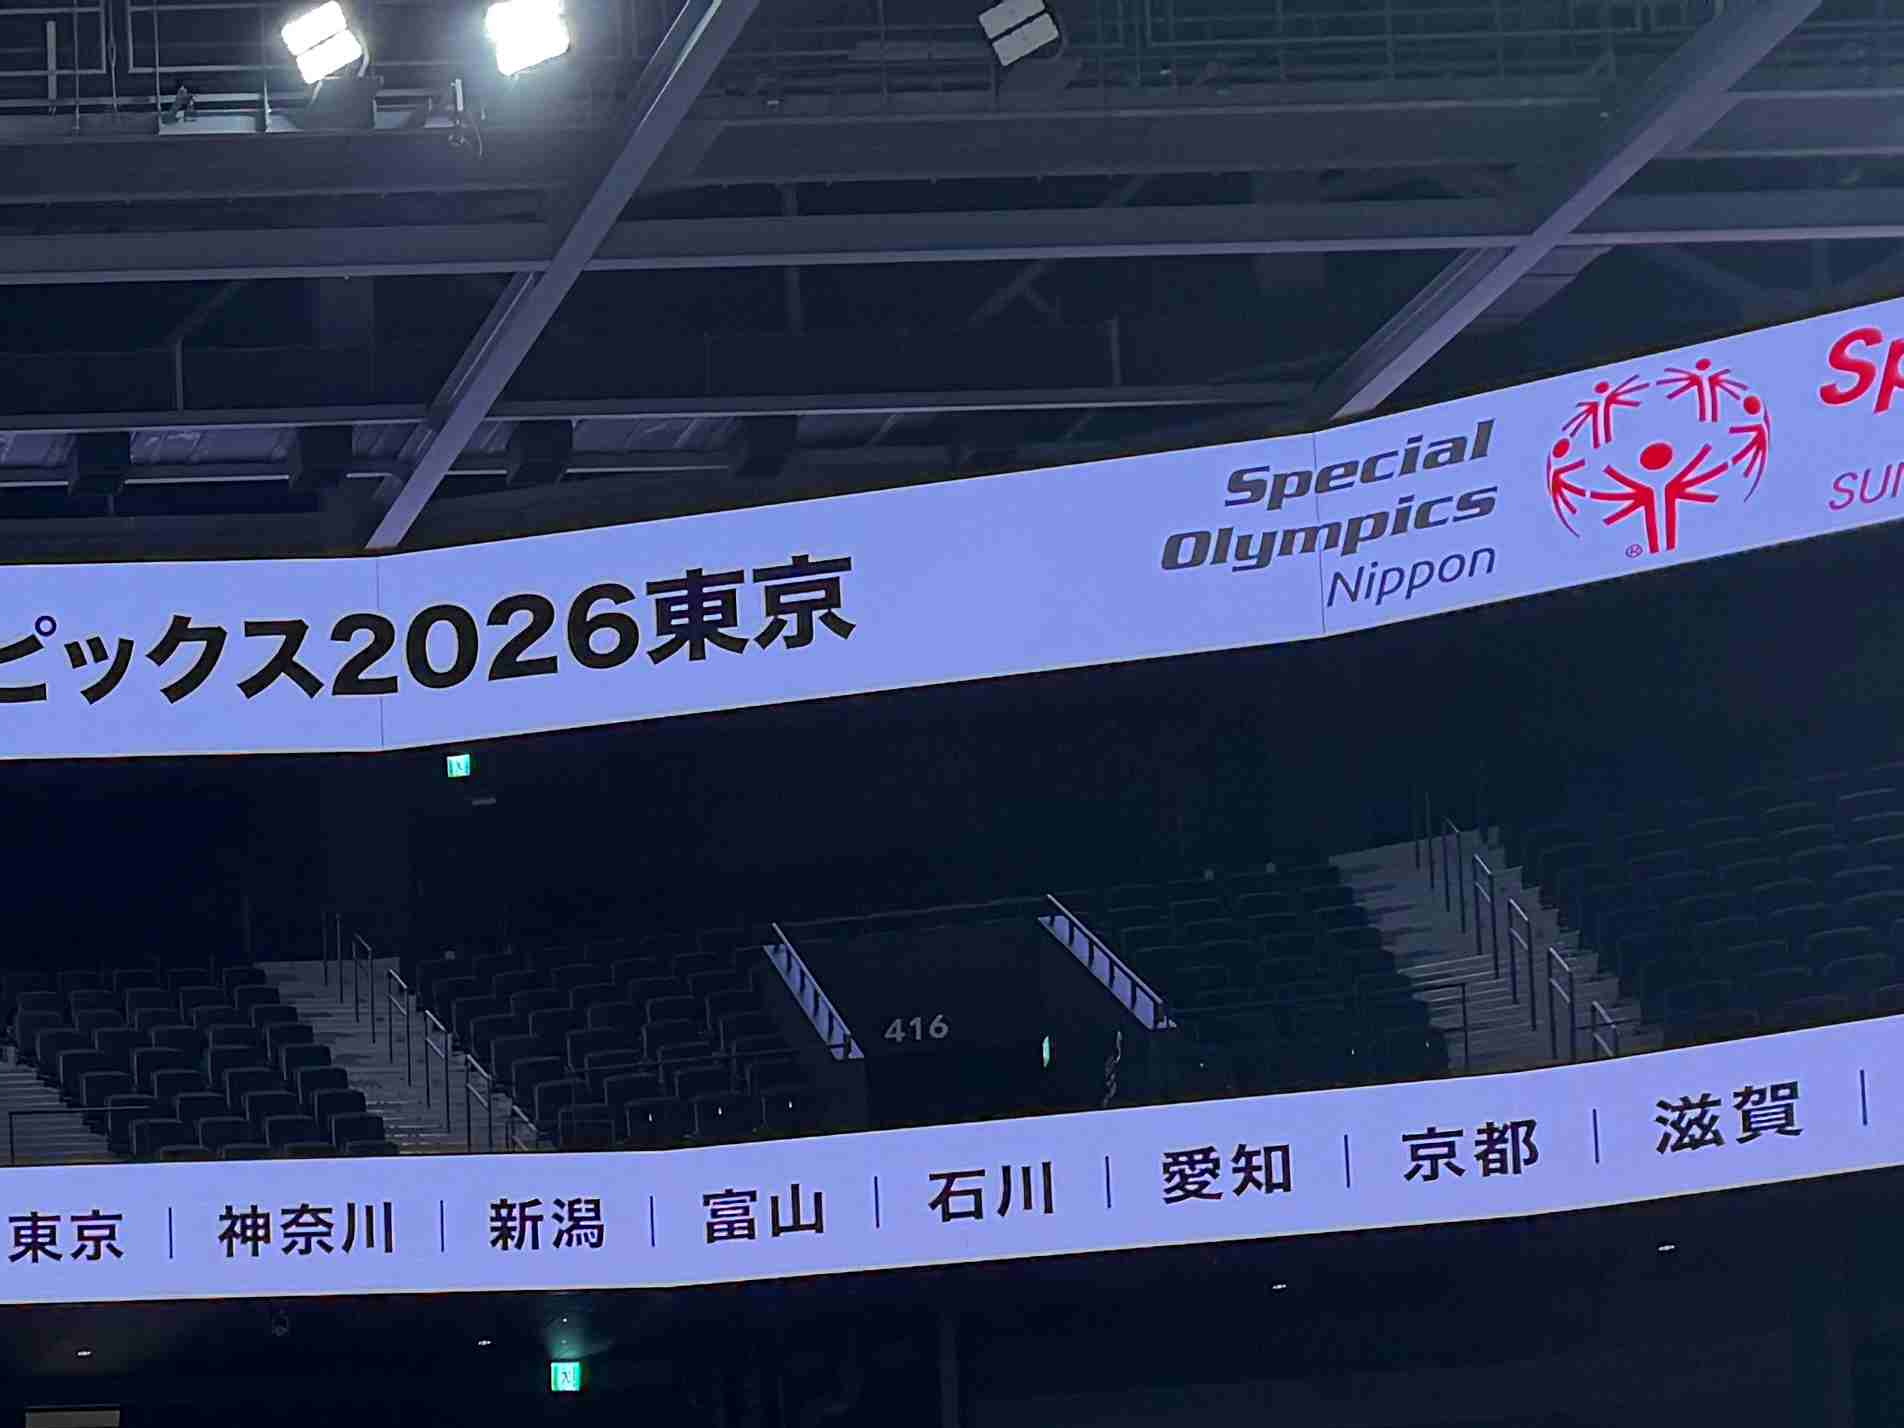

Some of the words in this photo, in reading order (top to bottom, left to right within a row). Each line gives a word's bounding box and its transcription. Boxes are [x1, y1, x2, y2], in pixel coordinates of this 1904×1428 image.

[1224, 419, 1496, 511] Special
[1161, 486, 1498, 573] Olympics
[1327, 547, 1496, 607] Nippon
[883, 1014, 949, 1042] 416
[7, 1209, 125, 1264] 東京
[217, 1201, 394, 1258] 神奈川
[489, 1196, 605, 1252] 新潟
[702, 1183, 825, 1245] 富山
[927, 1160, 1055, 1223] 石川
[1162, 1143, 1293, 1205] 愛知
[1401, 1119, 1539, 1183] 京都
[1654, 1080, 1804, 1156] 滋賀
